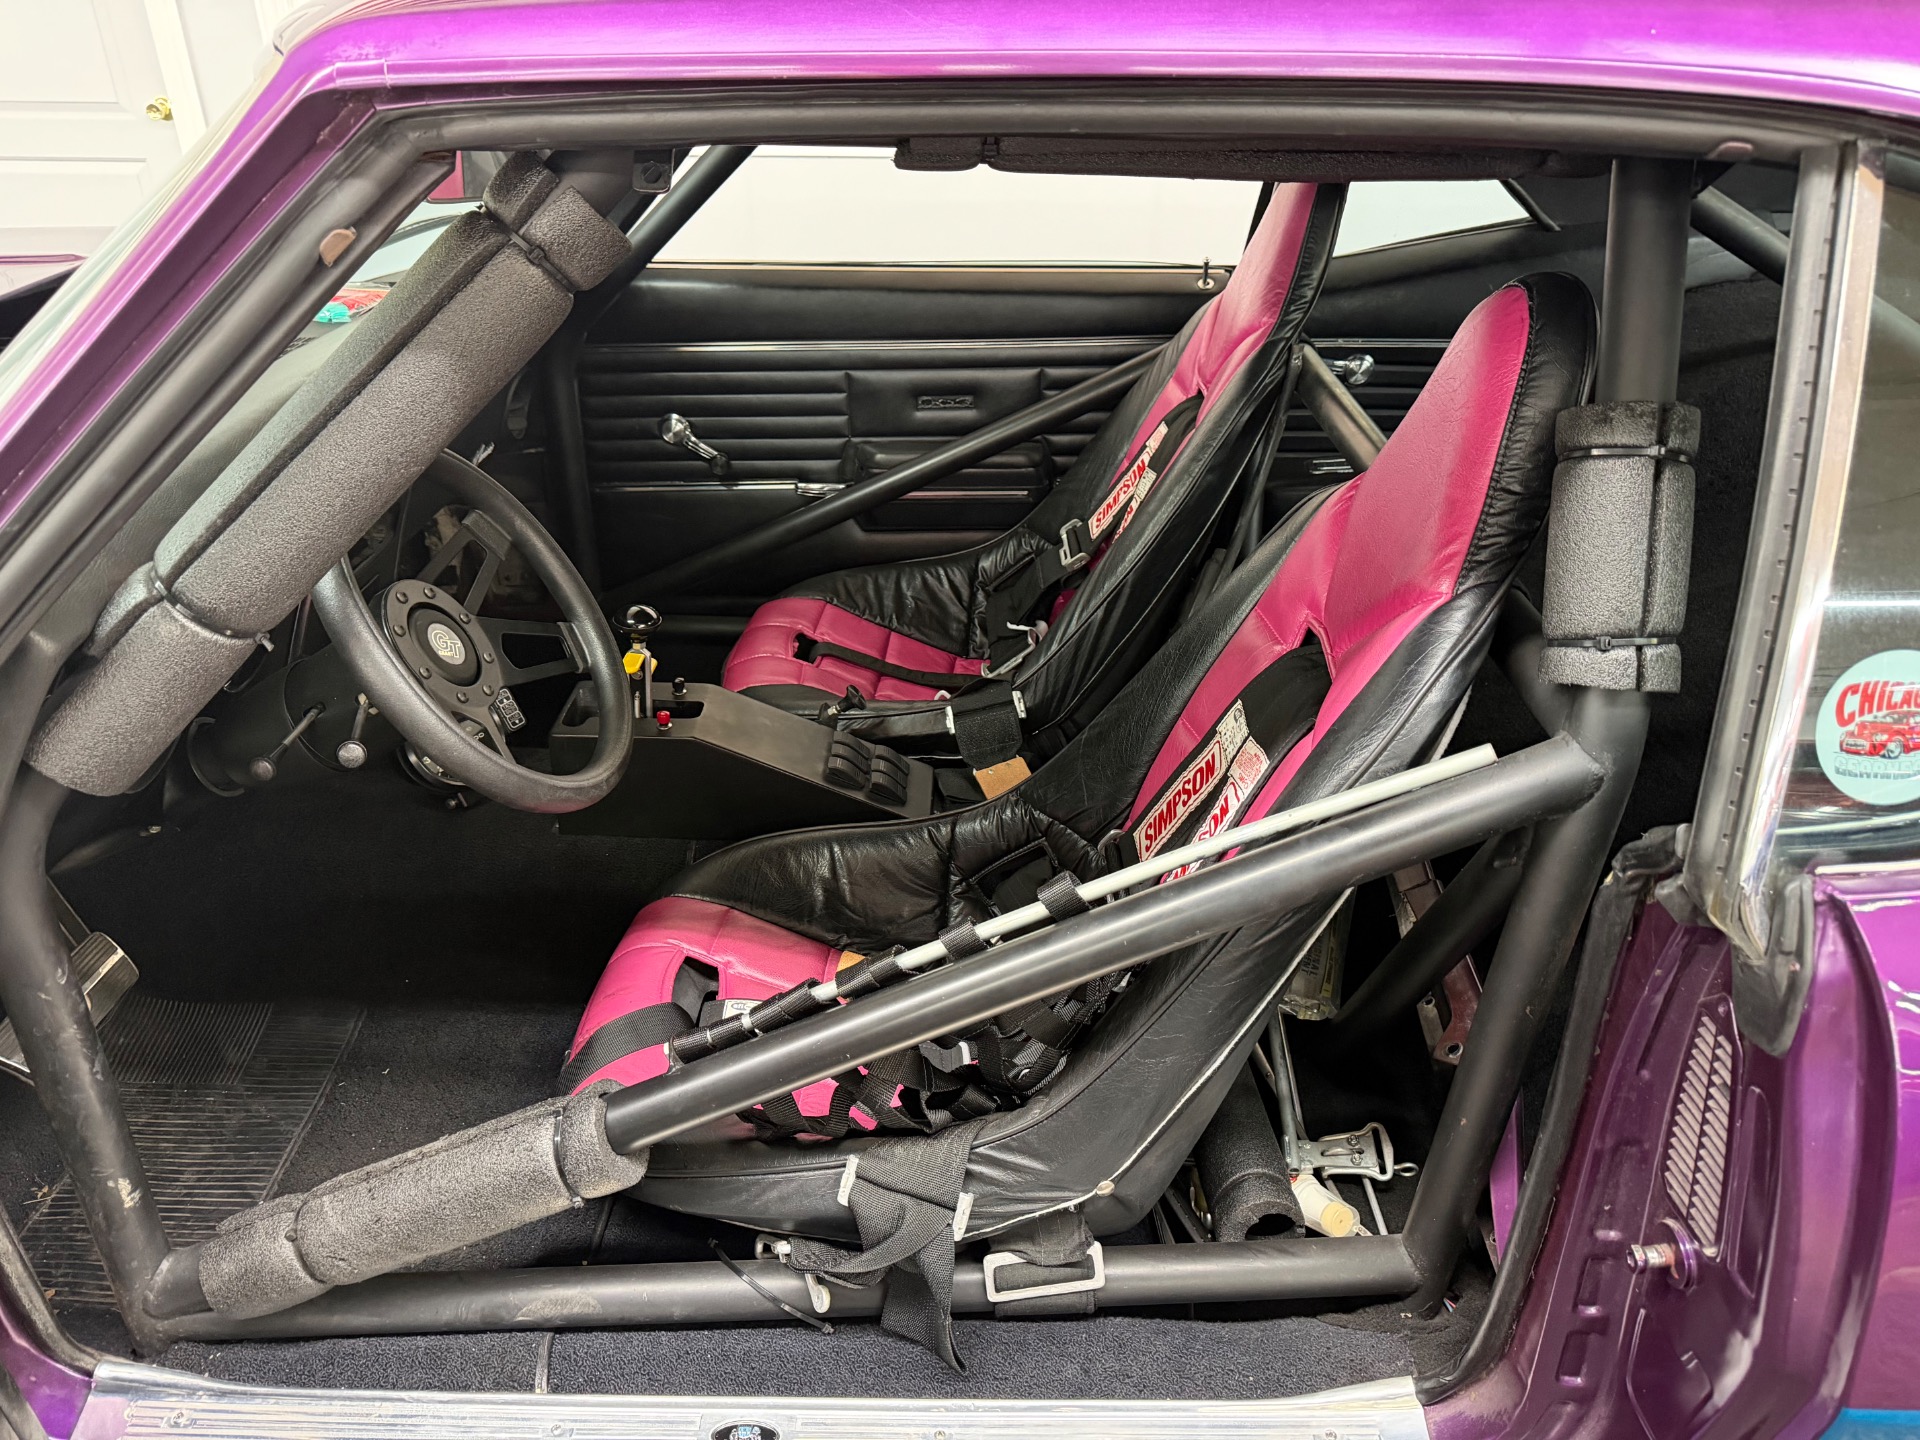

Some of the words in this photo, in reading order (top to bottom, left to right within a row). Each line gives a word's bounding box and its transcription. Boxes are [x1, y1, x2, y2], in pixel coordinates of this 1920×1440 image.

[1095, 458, 1146, 529] SIMPSON
[431, 630, 461, 658] GT
[1145, 752, 1216, 853] SIMPSON
